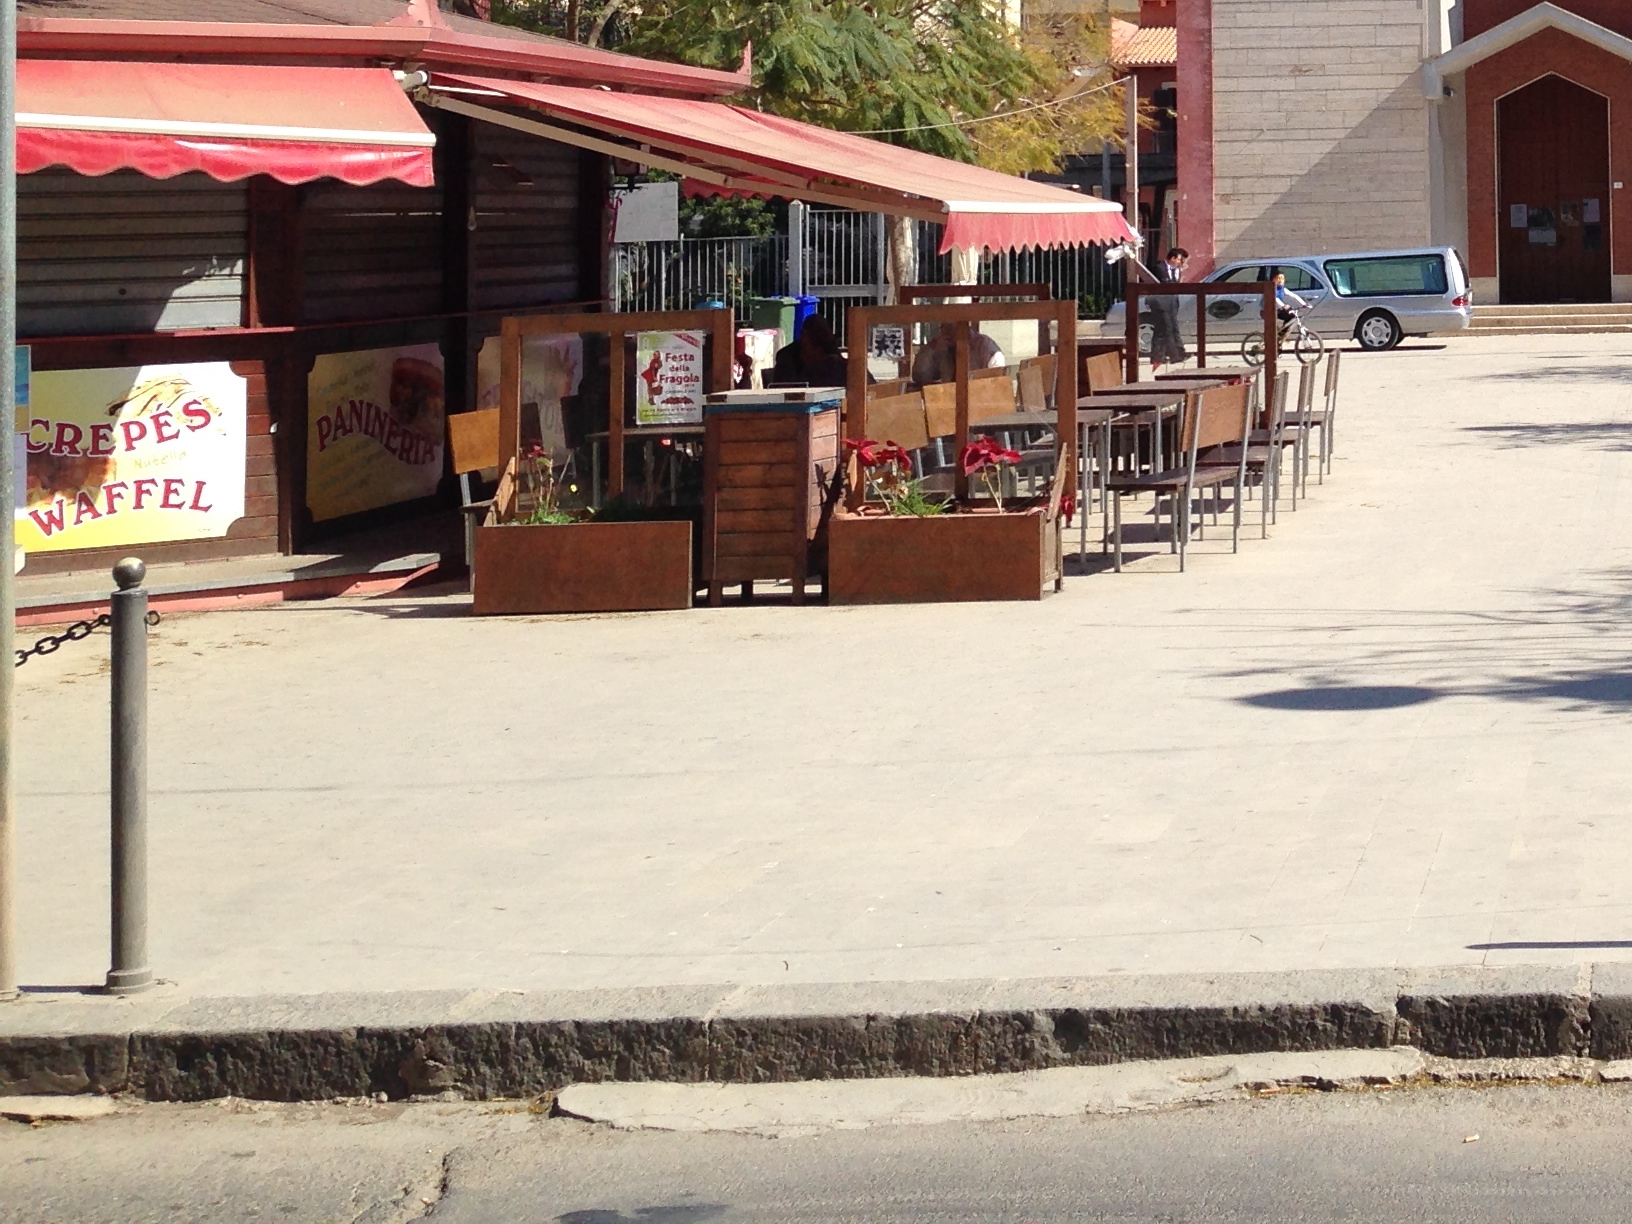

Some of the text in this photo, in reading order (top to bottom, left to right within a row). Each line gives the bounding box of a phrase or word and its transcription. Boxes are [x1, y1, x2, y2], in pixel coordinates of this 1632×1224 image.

[665, 352, 695, 362] Festa
[669, 364, 690, 372] della
[659, 373, 700, 385] Fragola
[24, 398, 212, 458] CREPÉS
[316, 399, 436, 466] PANINERIA
[134, 450, 187, 470] Nutella
[28, 478, 213, 537] WAFFEL
